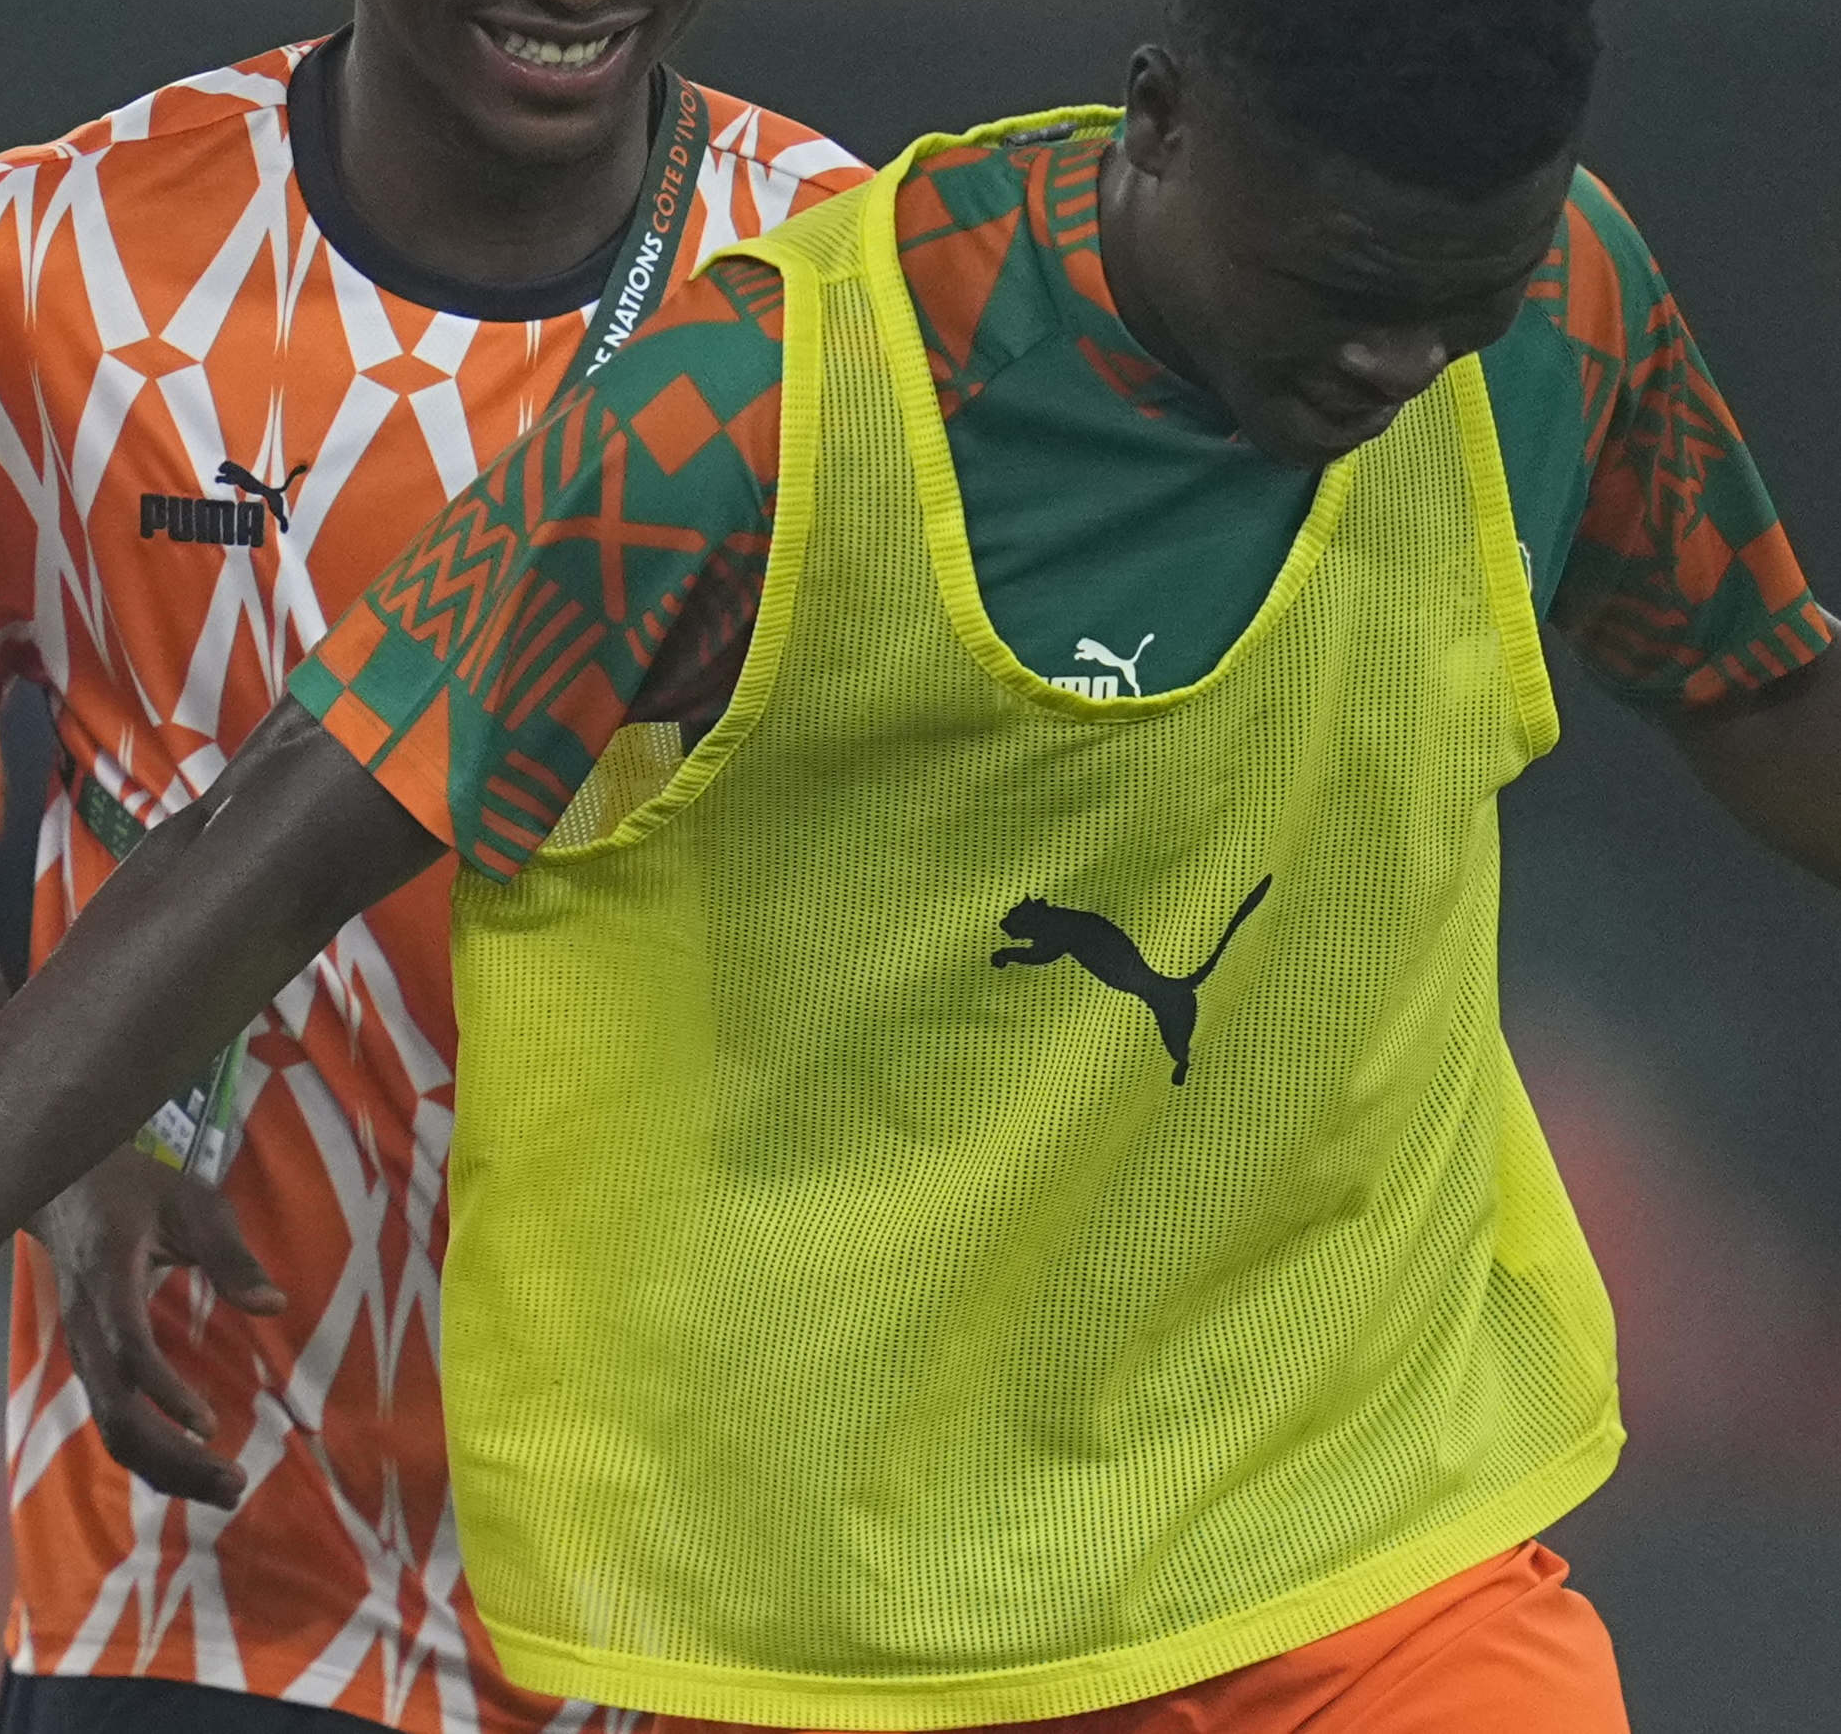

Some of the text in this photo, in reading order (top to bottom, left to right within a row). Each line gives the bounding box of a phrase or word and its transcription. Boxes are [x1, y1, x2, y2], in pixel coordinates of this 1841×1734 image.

[603, 231, 663, 349] NATIONS
[652, 165, 687, 234] CÔTE
[140, 493, 264, 547] PUMA
